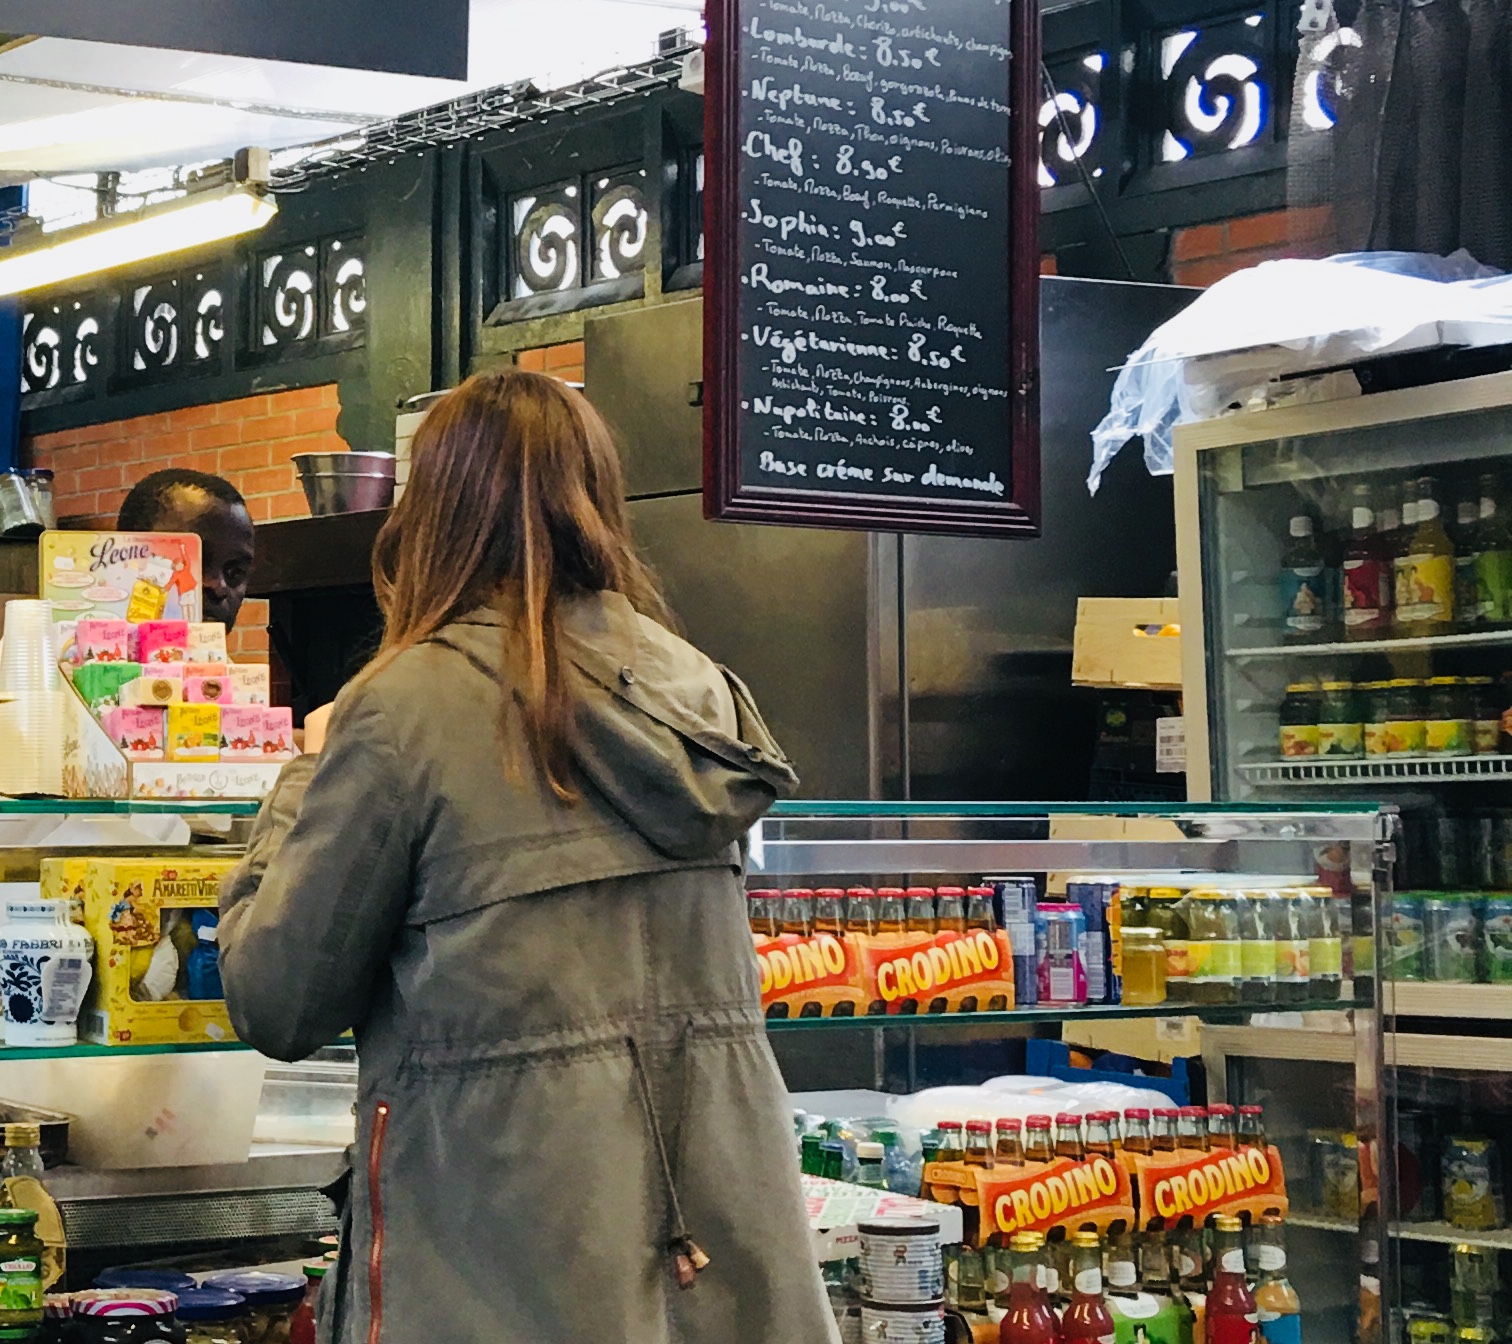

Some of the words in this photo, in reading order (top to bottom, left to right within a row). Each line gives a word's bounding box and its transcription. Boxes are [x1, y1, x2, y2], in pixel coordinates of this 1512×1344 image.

[759, 450, 807, 476] Base
[921, 463, 1004, 496] demande
[12, 939, 63, 950] FABBRI
[877, 931, 999, 1002] CRODINO
[995, 1157, 1117, 1233] CRODINO
[1154, 1147, 1271, 1218] CRODINO
